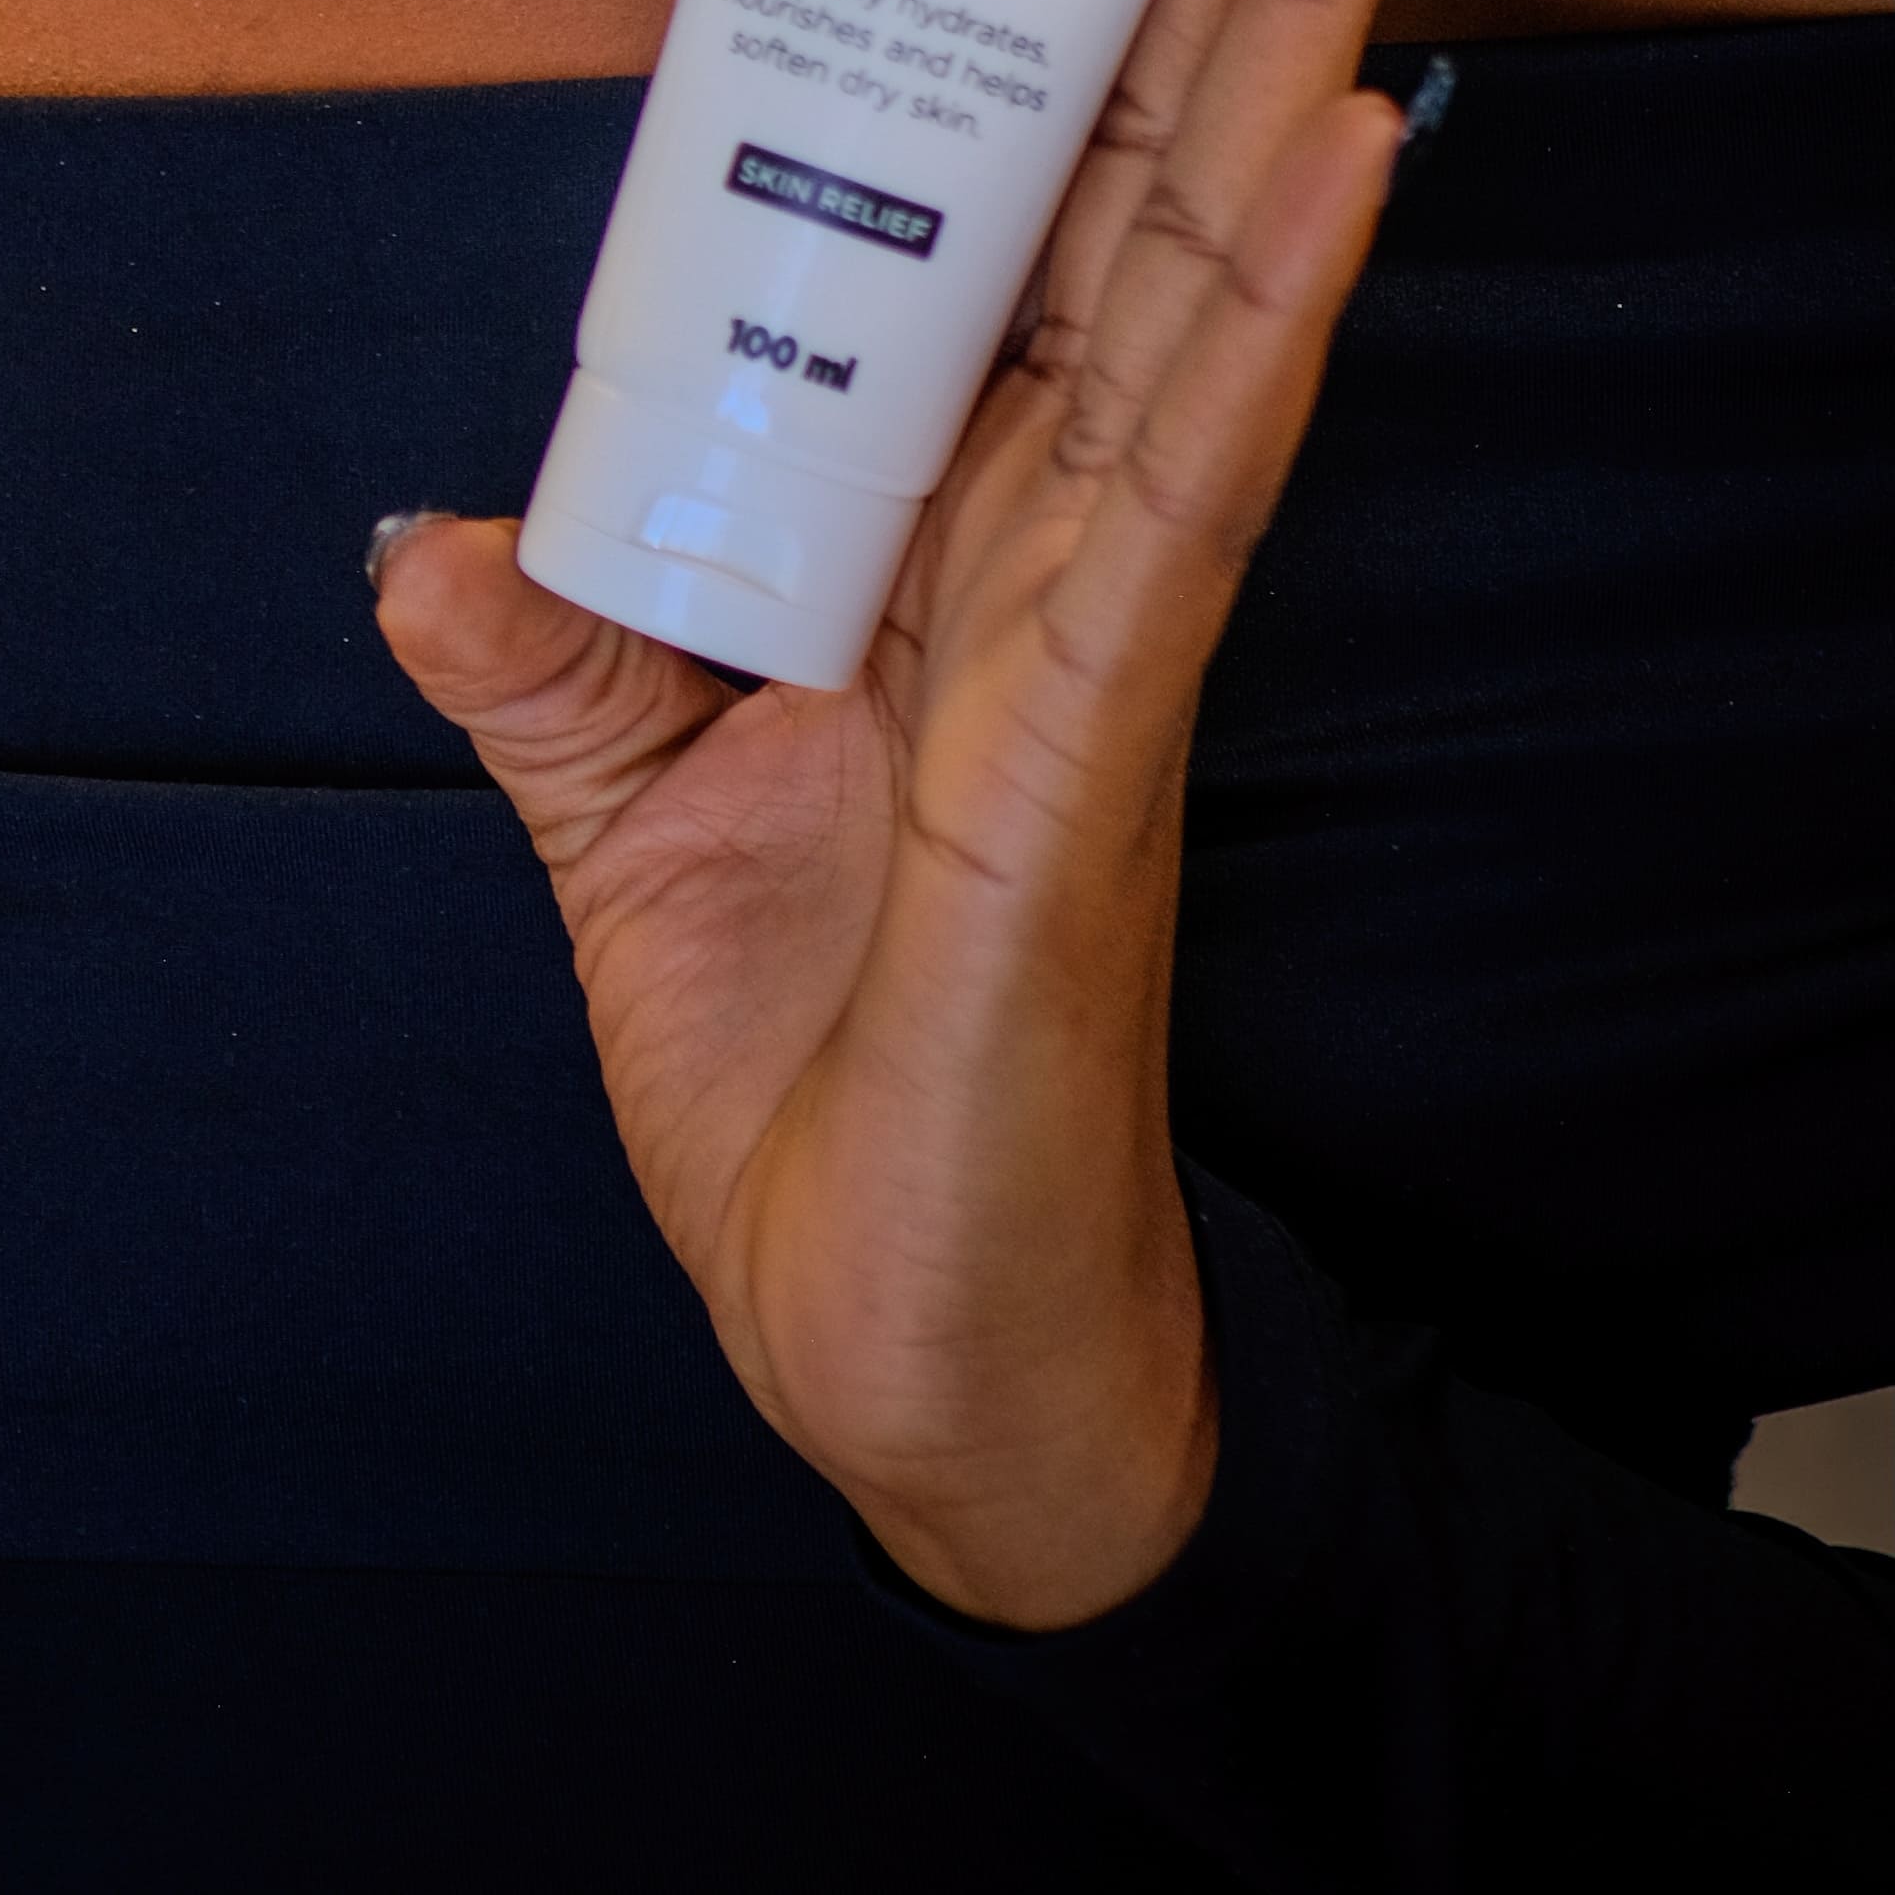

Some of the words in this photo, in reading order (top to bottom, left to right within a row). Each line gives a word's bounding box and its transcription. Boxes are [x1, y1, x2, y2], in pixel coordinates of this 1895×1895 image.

[728, 30, 829, 84] soften
[838, 69, 900, 112] dry
[885, 39, 954, 79] and
[962, 59, 1049, 112] helps
[738, 155, 813, 205] SKIN
[817, 186, 934, 243] RELIEF
[727, 317, 799, 371] 100
[803, 353, 858, 395] ml
